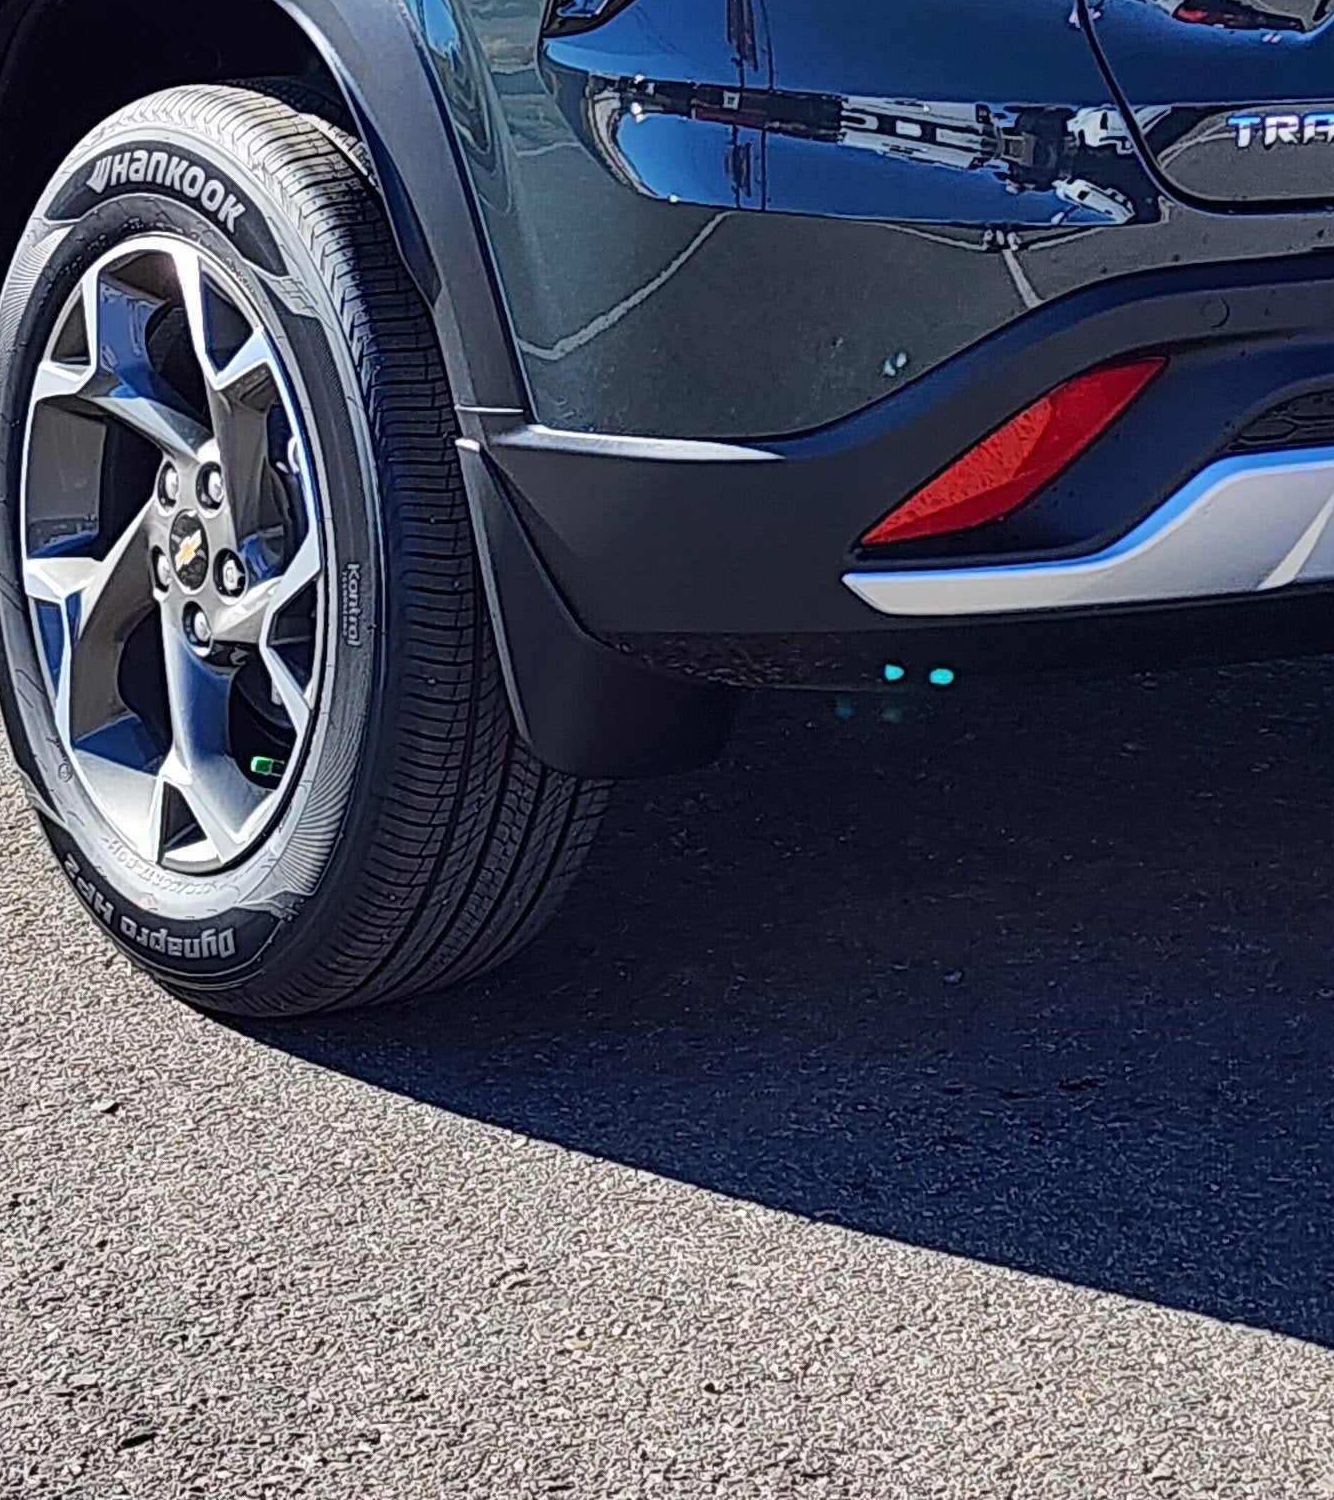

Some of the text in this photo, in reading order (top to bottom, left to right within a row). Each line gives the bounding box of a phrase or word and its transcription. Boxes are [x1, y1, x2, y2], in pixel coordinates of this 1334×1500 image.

[347, 563, 362, 646] Kontrol
[63, 852, 115, 925] HP2
[120, 915, 237, 959] Dynapro
